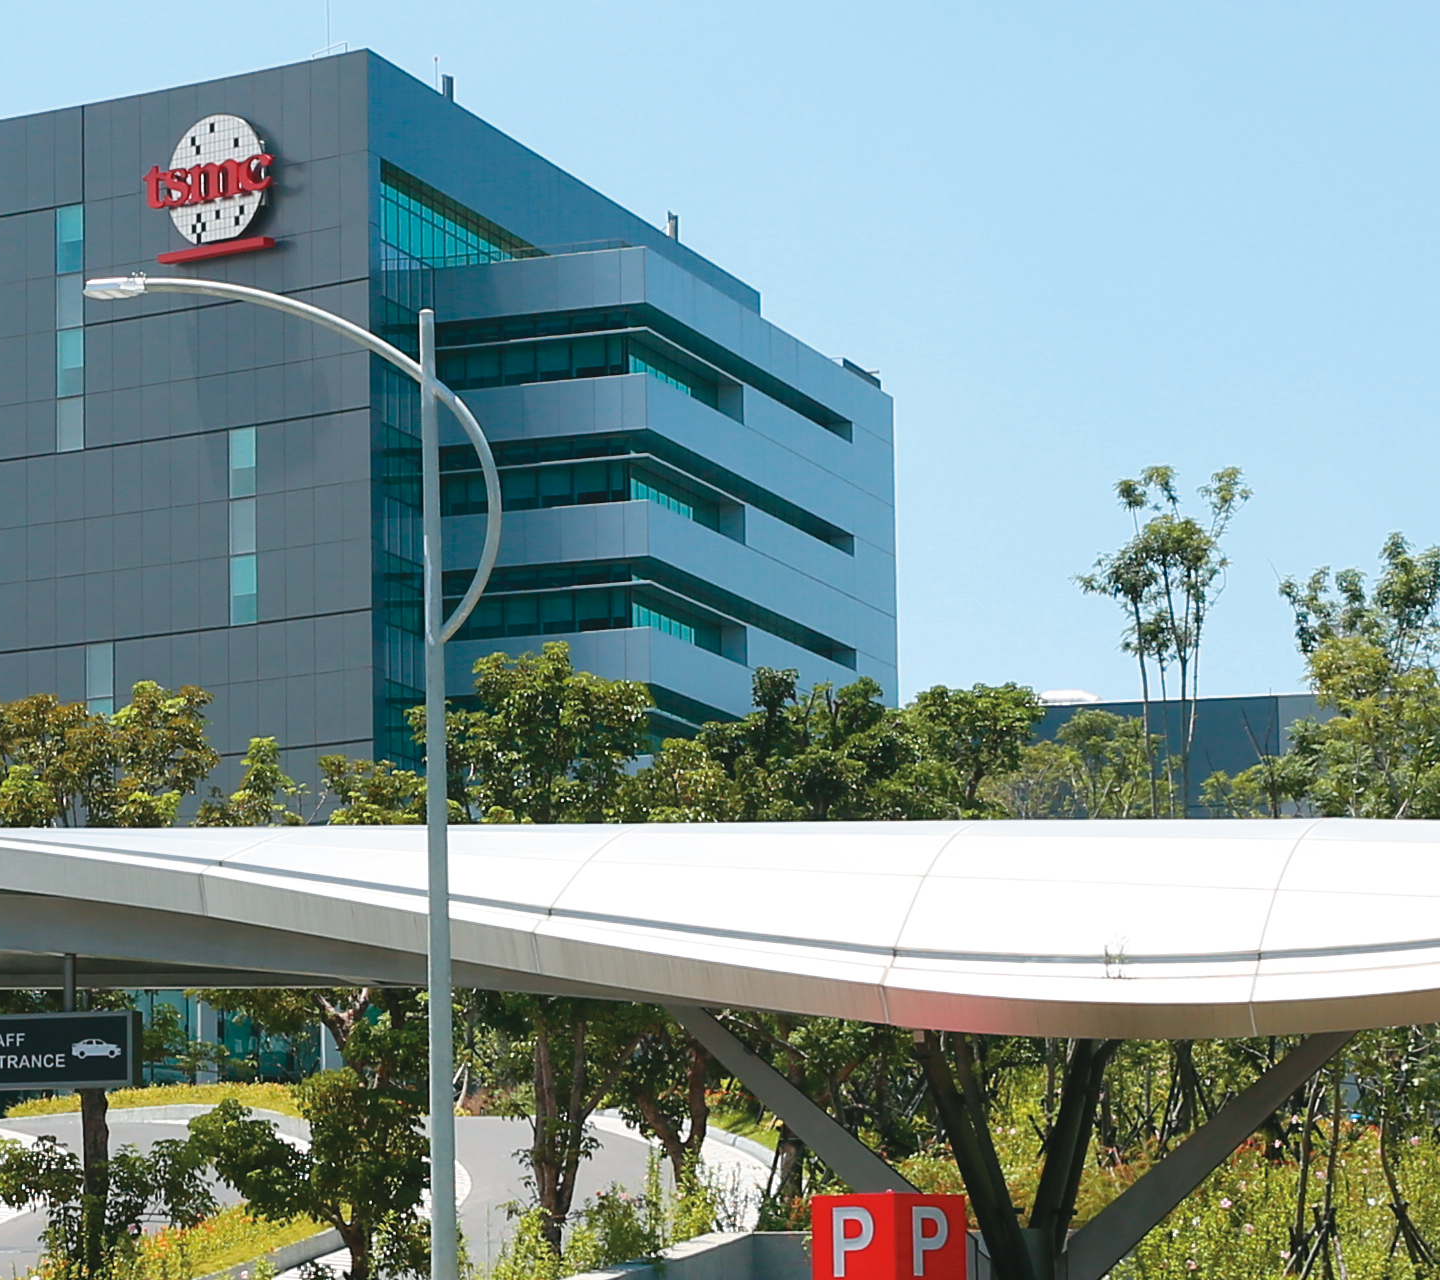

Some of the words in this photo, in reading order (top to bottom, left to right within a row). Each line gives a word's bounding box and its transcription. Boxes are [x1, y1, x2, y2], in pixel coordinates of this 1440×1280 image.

[142, 152, 276, 210] tsmc
[832, 1206, 874, 1278] P
[912, 1205, 949, 1277] P
